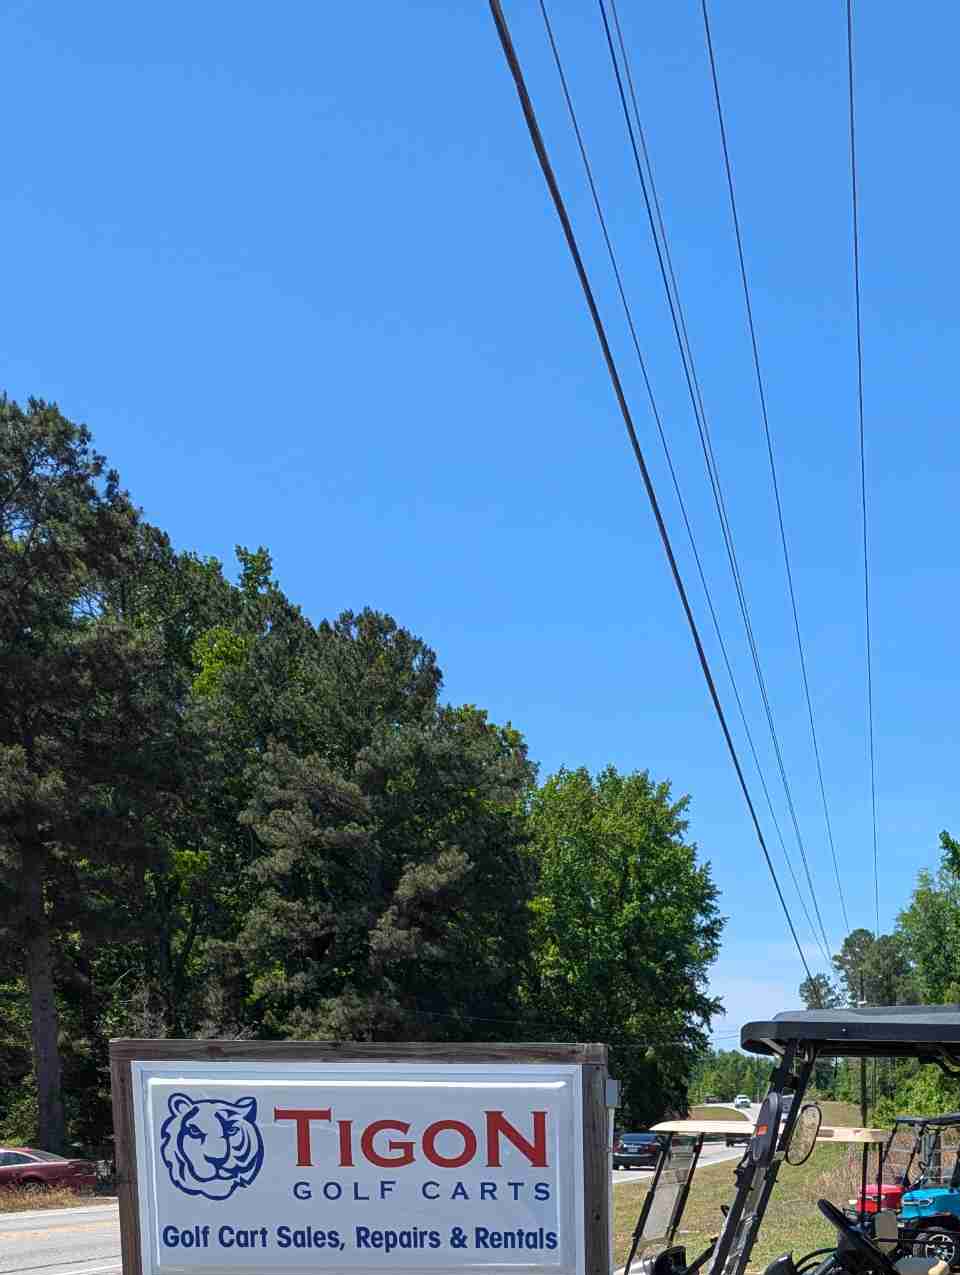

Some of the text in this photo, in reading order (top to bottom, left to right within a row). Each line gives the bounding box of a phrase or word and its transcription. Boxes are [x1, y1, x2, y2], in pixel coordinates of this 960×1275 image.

[273, 1107, 550, 1169] TIGON
[292, 1181, 551, 1202] GOLF CARTS
[162, 1225, 558, 1254] Golf Cart Sales, Repairs & Rentals
